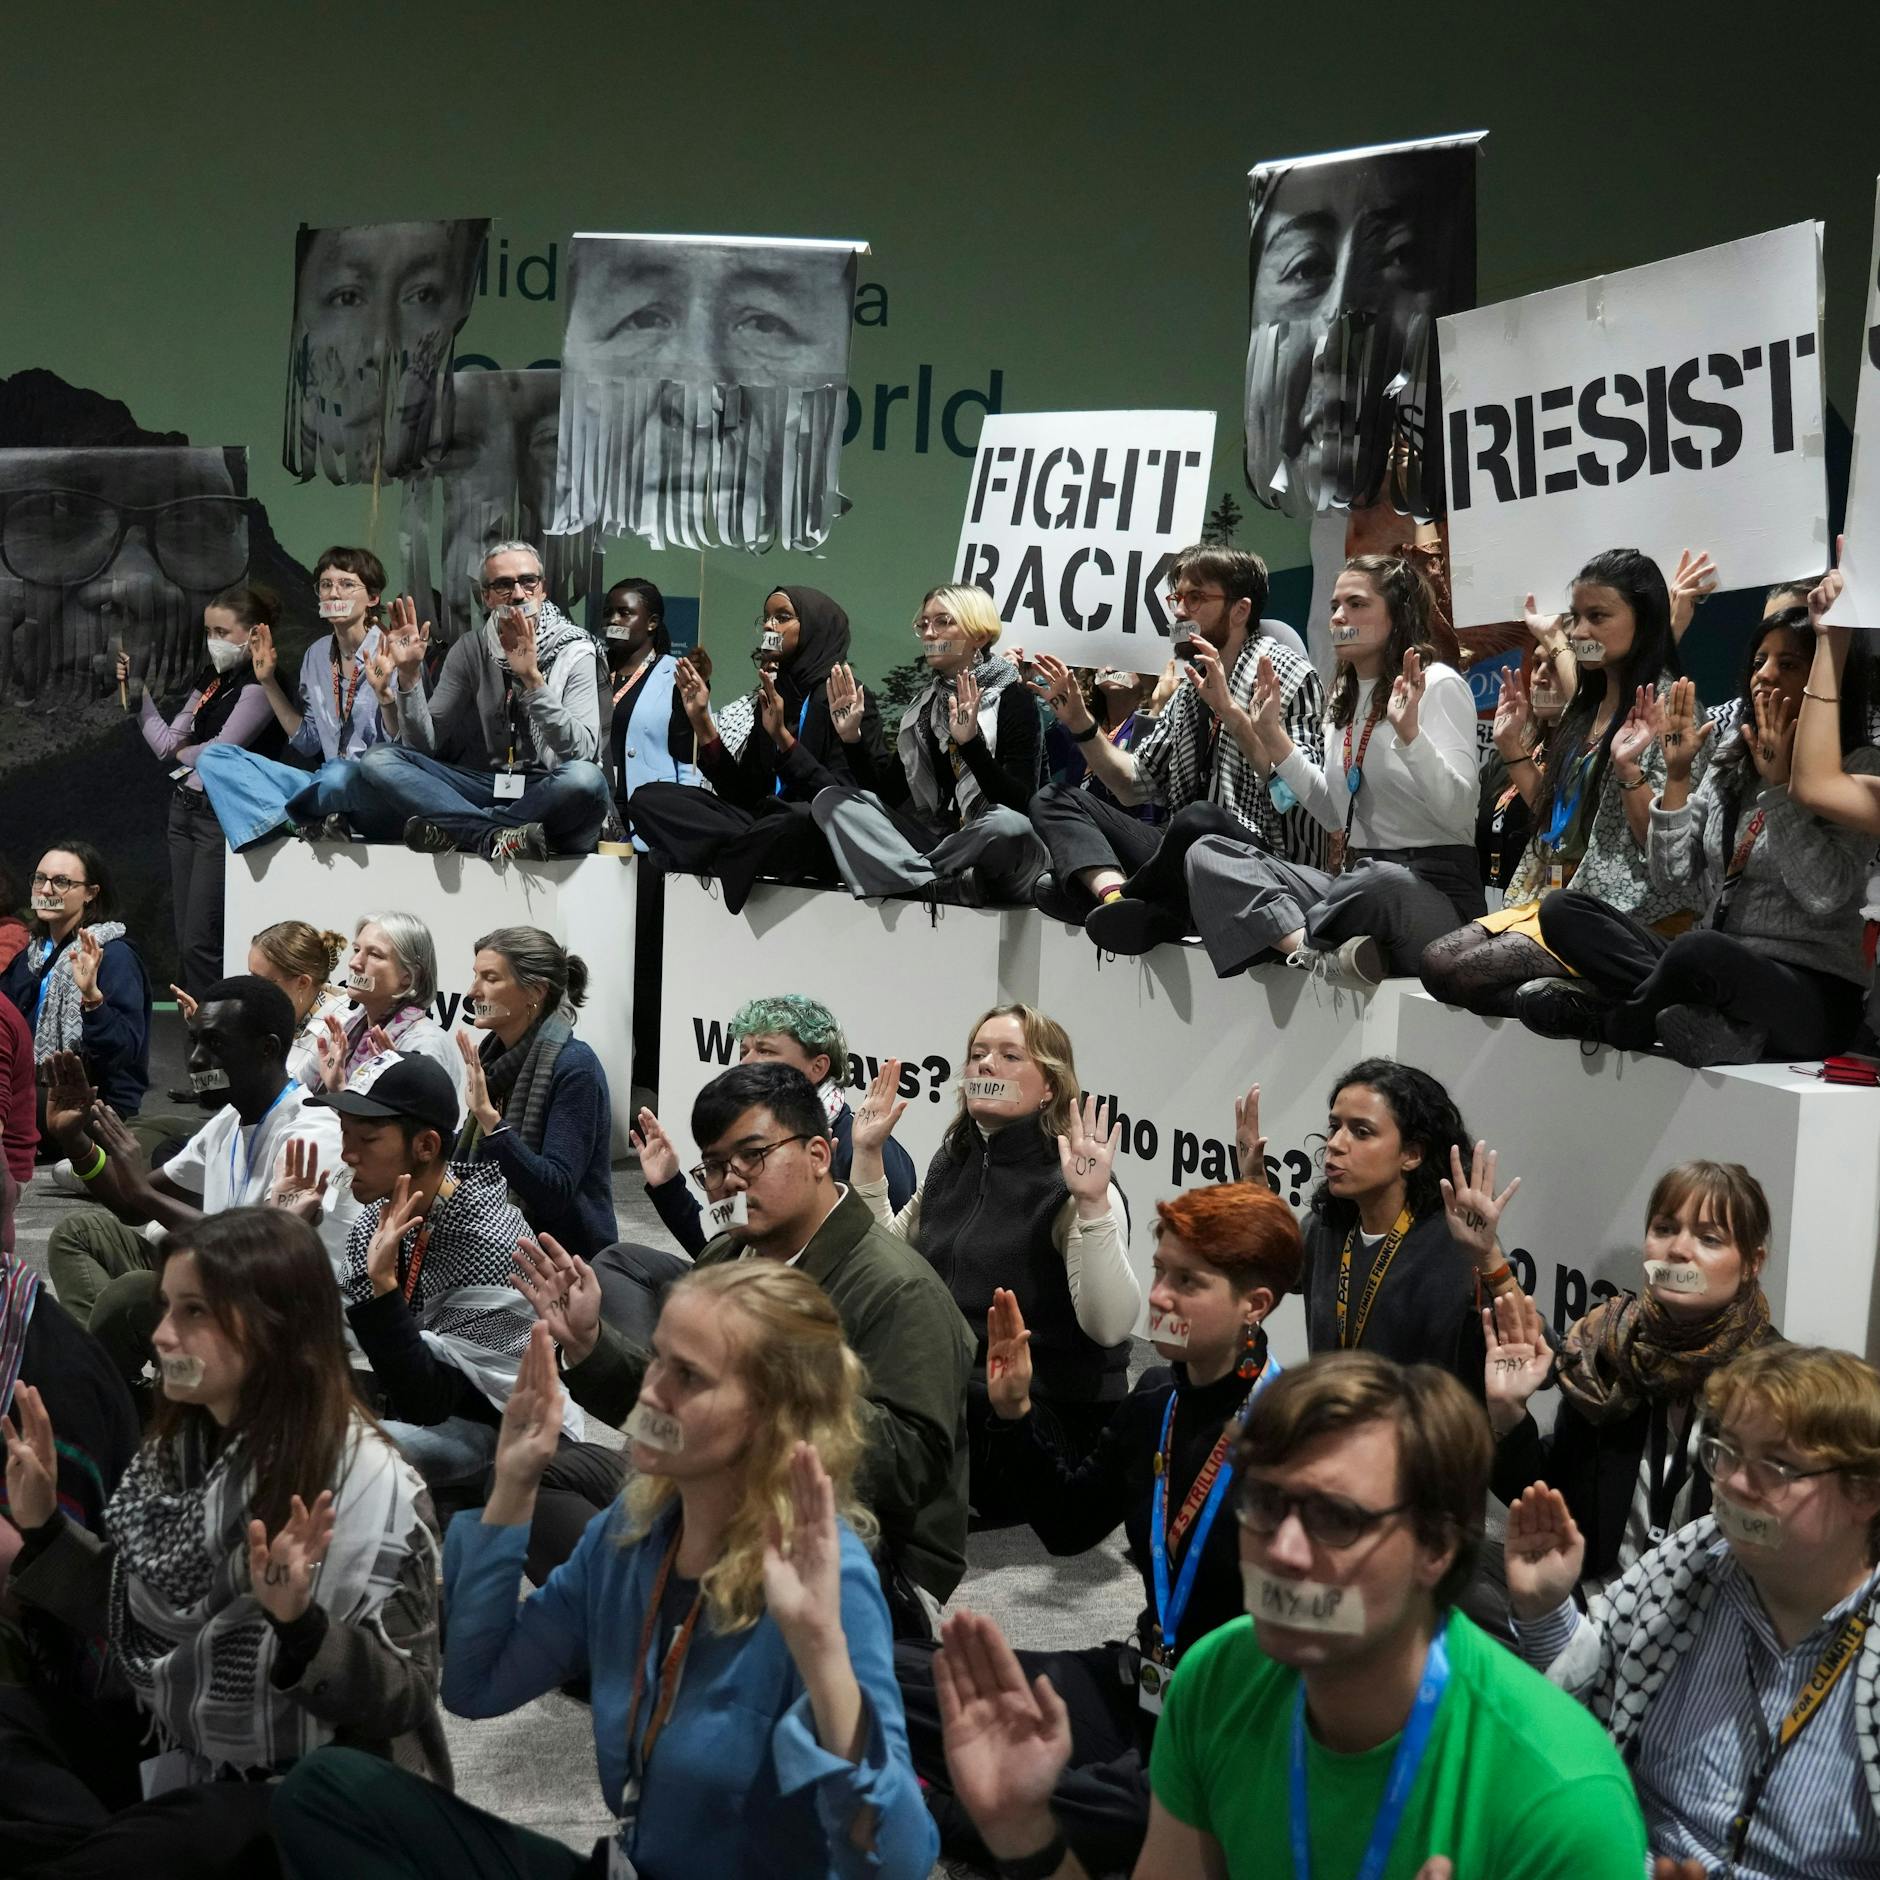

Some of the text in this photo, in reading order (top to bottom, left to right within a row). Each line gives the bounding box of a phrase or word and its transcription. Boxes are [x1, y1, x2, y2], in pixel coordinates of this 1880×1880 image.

[1448, 332, 1816, 512] RESIST
[970, 446, 1201, 535] FIGHT
[962, 543, 1180, 638] BACK
[1340, 628, 1360, 640] UP!
[353, 977, 368, 988] UP!
[968, 1083, 1005, 1096] PAY UP!
[858, 1107, 878, 1124] PAY
[1075, 1157, 1096, 1176] UP
[1466, 1211, 1488, 1233] UP!
[1338, 1263, 1350, 1305] PAY
[1676, 1271, 1699, 1286] UP!
[1358, 1279, 1378, 1325] CLIMATE
[1170, 1321, 1189, 1337] UP
[1494, 1357, 1529, 1376] PAY
[1261, 1580, 1343, 1617] PAY UP
[1791, 1693, 1813, 1722] FOR
